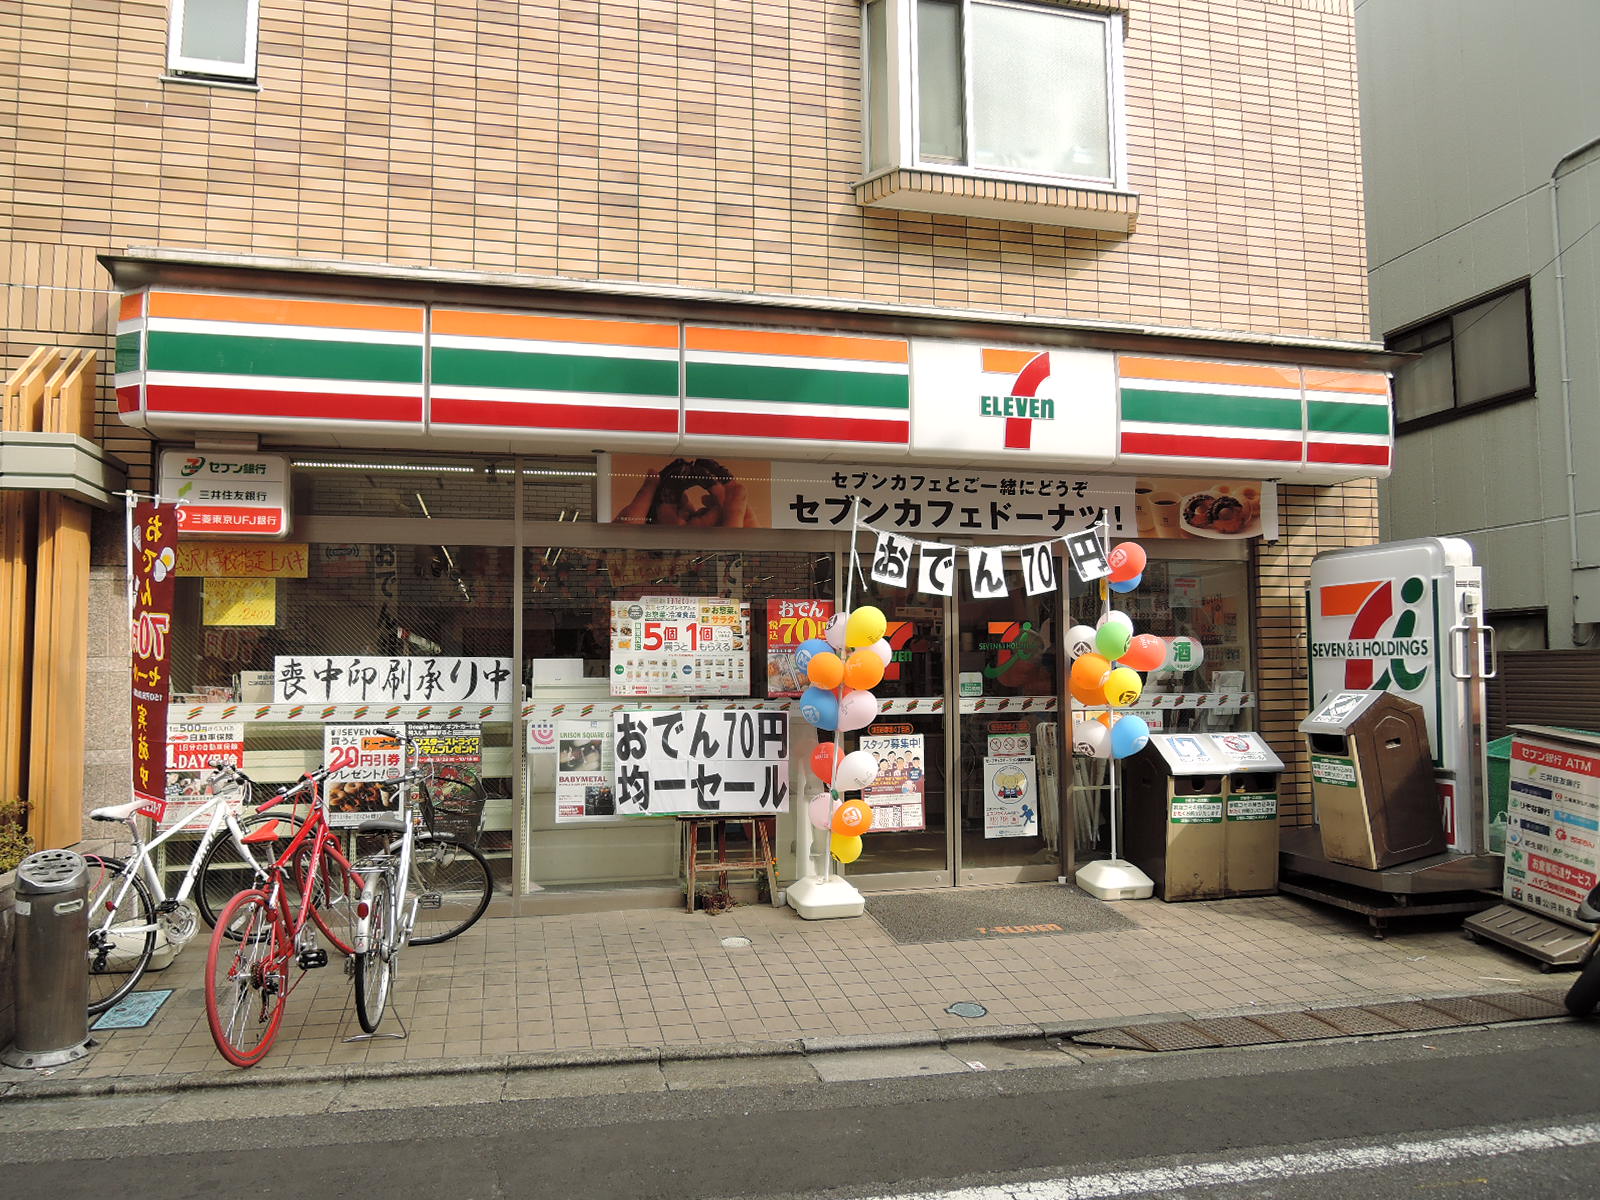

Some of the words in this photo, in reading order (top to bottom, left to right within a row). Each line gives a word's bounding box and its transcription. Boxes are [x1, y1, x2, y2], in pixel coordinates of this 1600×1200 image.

[981, 348, 1050, 450] 7
[209, 462, 266, 475] セブン銀行
[831, 472, 1088, 498] セブンカフェとご一緒にどうぞ
[199, 490, 267, 502] 三井住友銀行
[192, 514, 277, 526] 三菱東京UFJ銀行
[779, 601, 824, 618] おでん
[1173, 641, 1192, 662] 酒
[1363, 640, 1429, 656] HOLDINGS
[278, 658, 511, 701] 喪中印刷承り中
[341, 728, 371, 736] SEVEN
[616, 712, 787, 761] おでん70円
[331, 737, 358, 746] 買うと
[863, 738, 921, 750] スタッフ募集中!
[1521, 747, 1562, 766] セブン銀行
[1566, 758, 1593, 772] ATM
[618, 764, 788, 811] 均一セール
